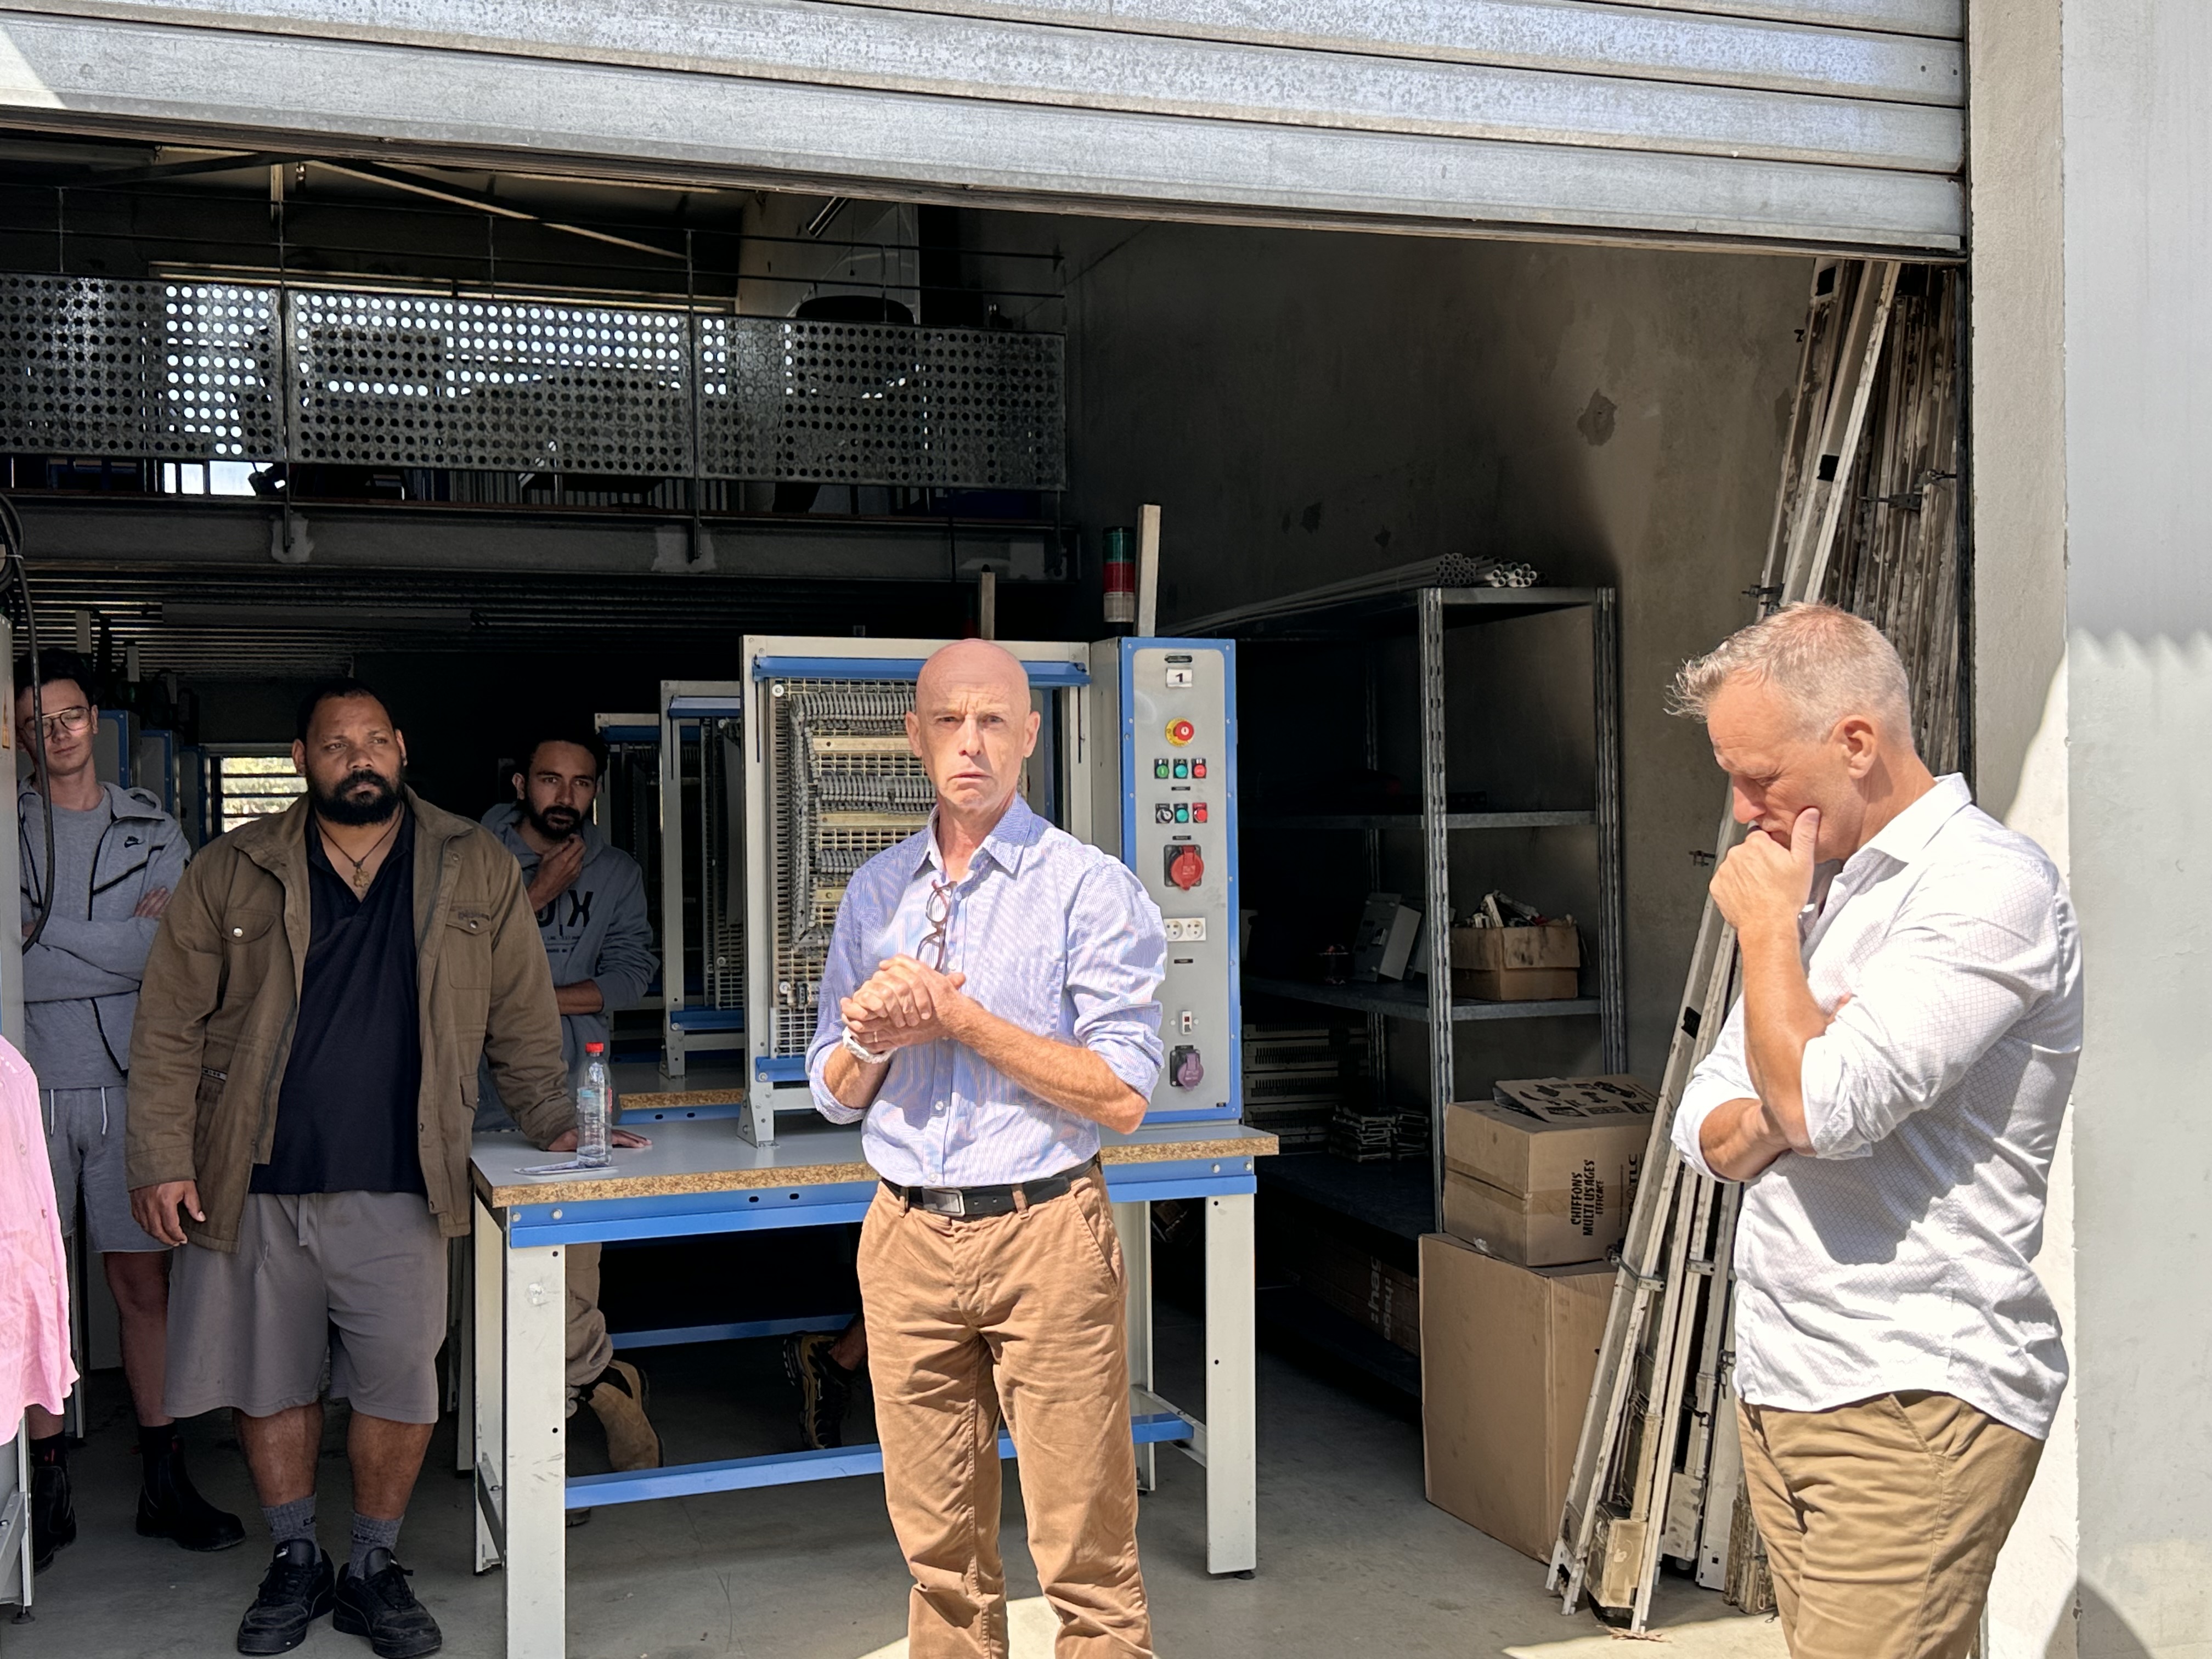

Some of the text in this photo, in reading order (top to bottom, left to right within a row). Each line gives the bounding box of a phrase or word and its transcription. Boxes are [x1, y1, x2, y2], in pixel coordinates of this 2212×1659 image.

[1176, 673, 1183, 682] 1
[1629, 1153, 1638, 1186] TLC
[1571, 1172, 1583, 1225] CHIFFONS
[1583, 1159, 1595, 1236] MULTI USAGES
